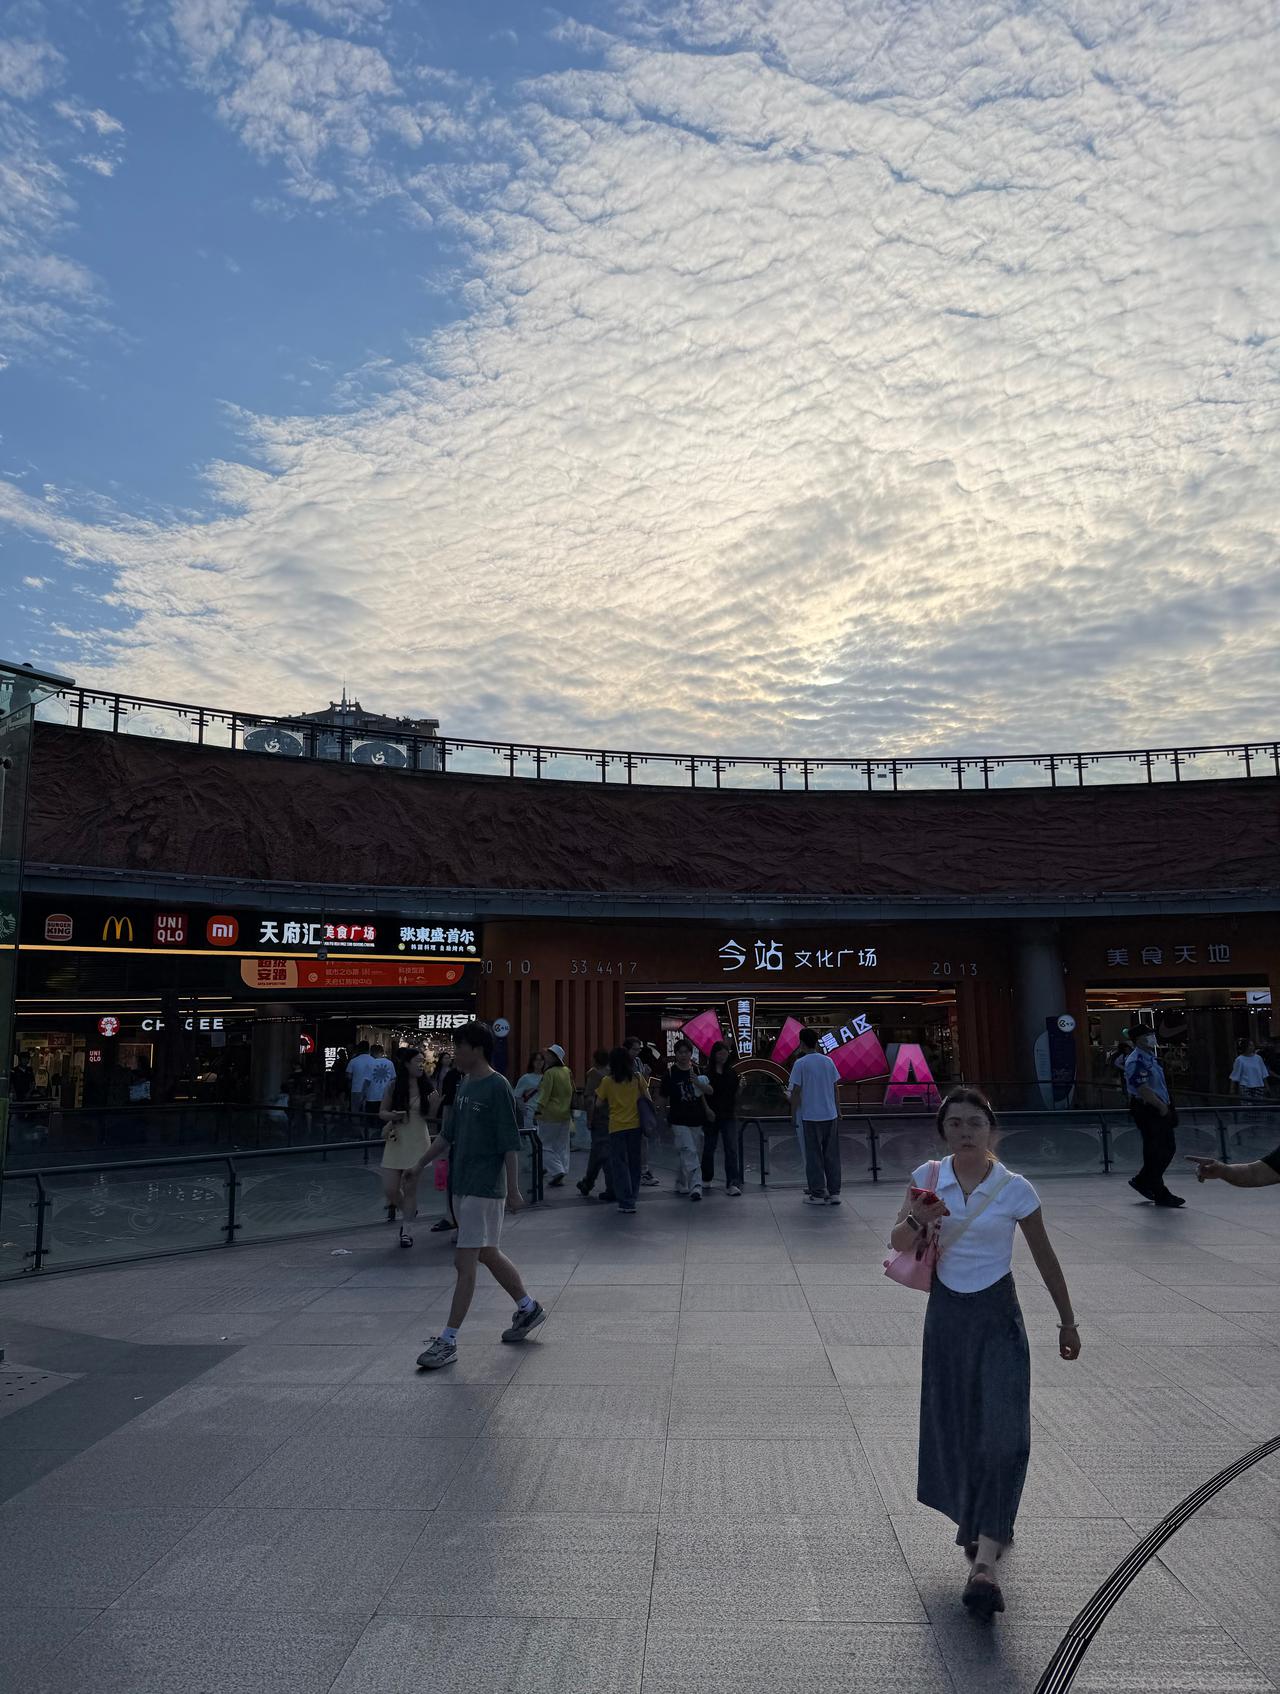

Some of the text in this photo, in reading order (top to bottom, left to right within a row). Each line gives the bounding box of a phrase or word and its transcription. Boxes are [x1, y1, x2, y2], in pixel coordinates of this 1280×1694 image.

[158, 916, 181, 928] UNI
[157, 930, 183, 943] QLO
[259, 920, 376, 946] 天府汇 美食广场
[718, 939, 878, 971] 今站 文化广场
[1105, 943, 1231, 967] 美食天地
[141, 1019, 224, 1031] CHGEE
[418, 1014, 477, 1029] 超级安
[737, 1000, 752, 1054] 美食天地
